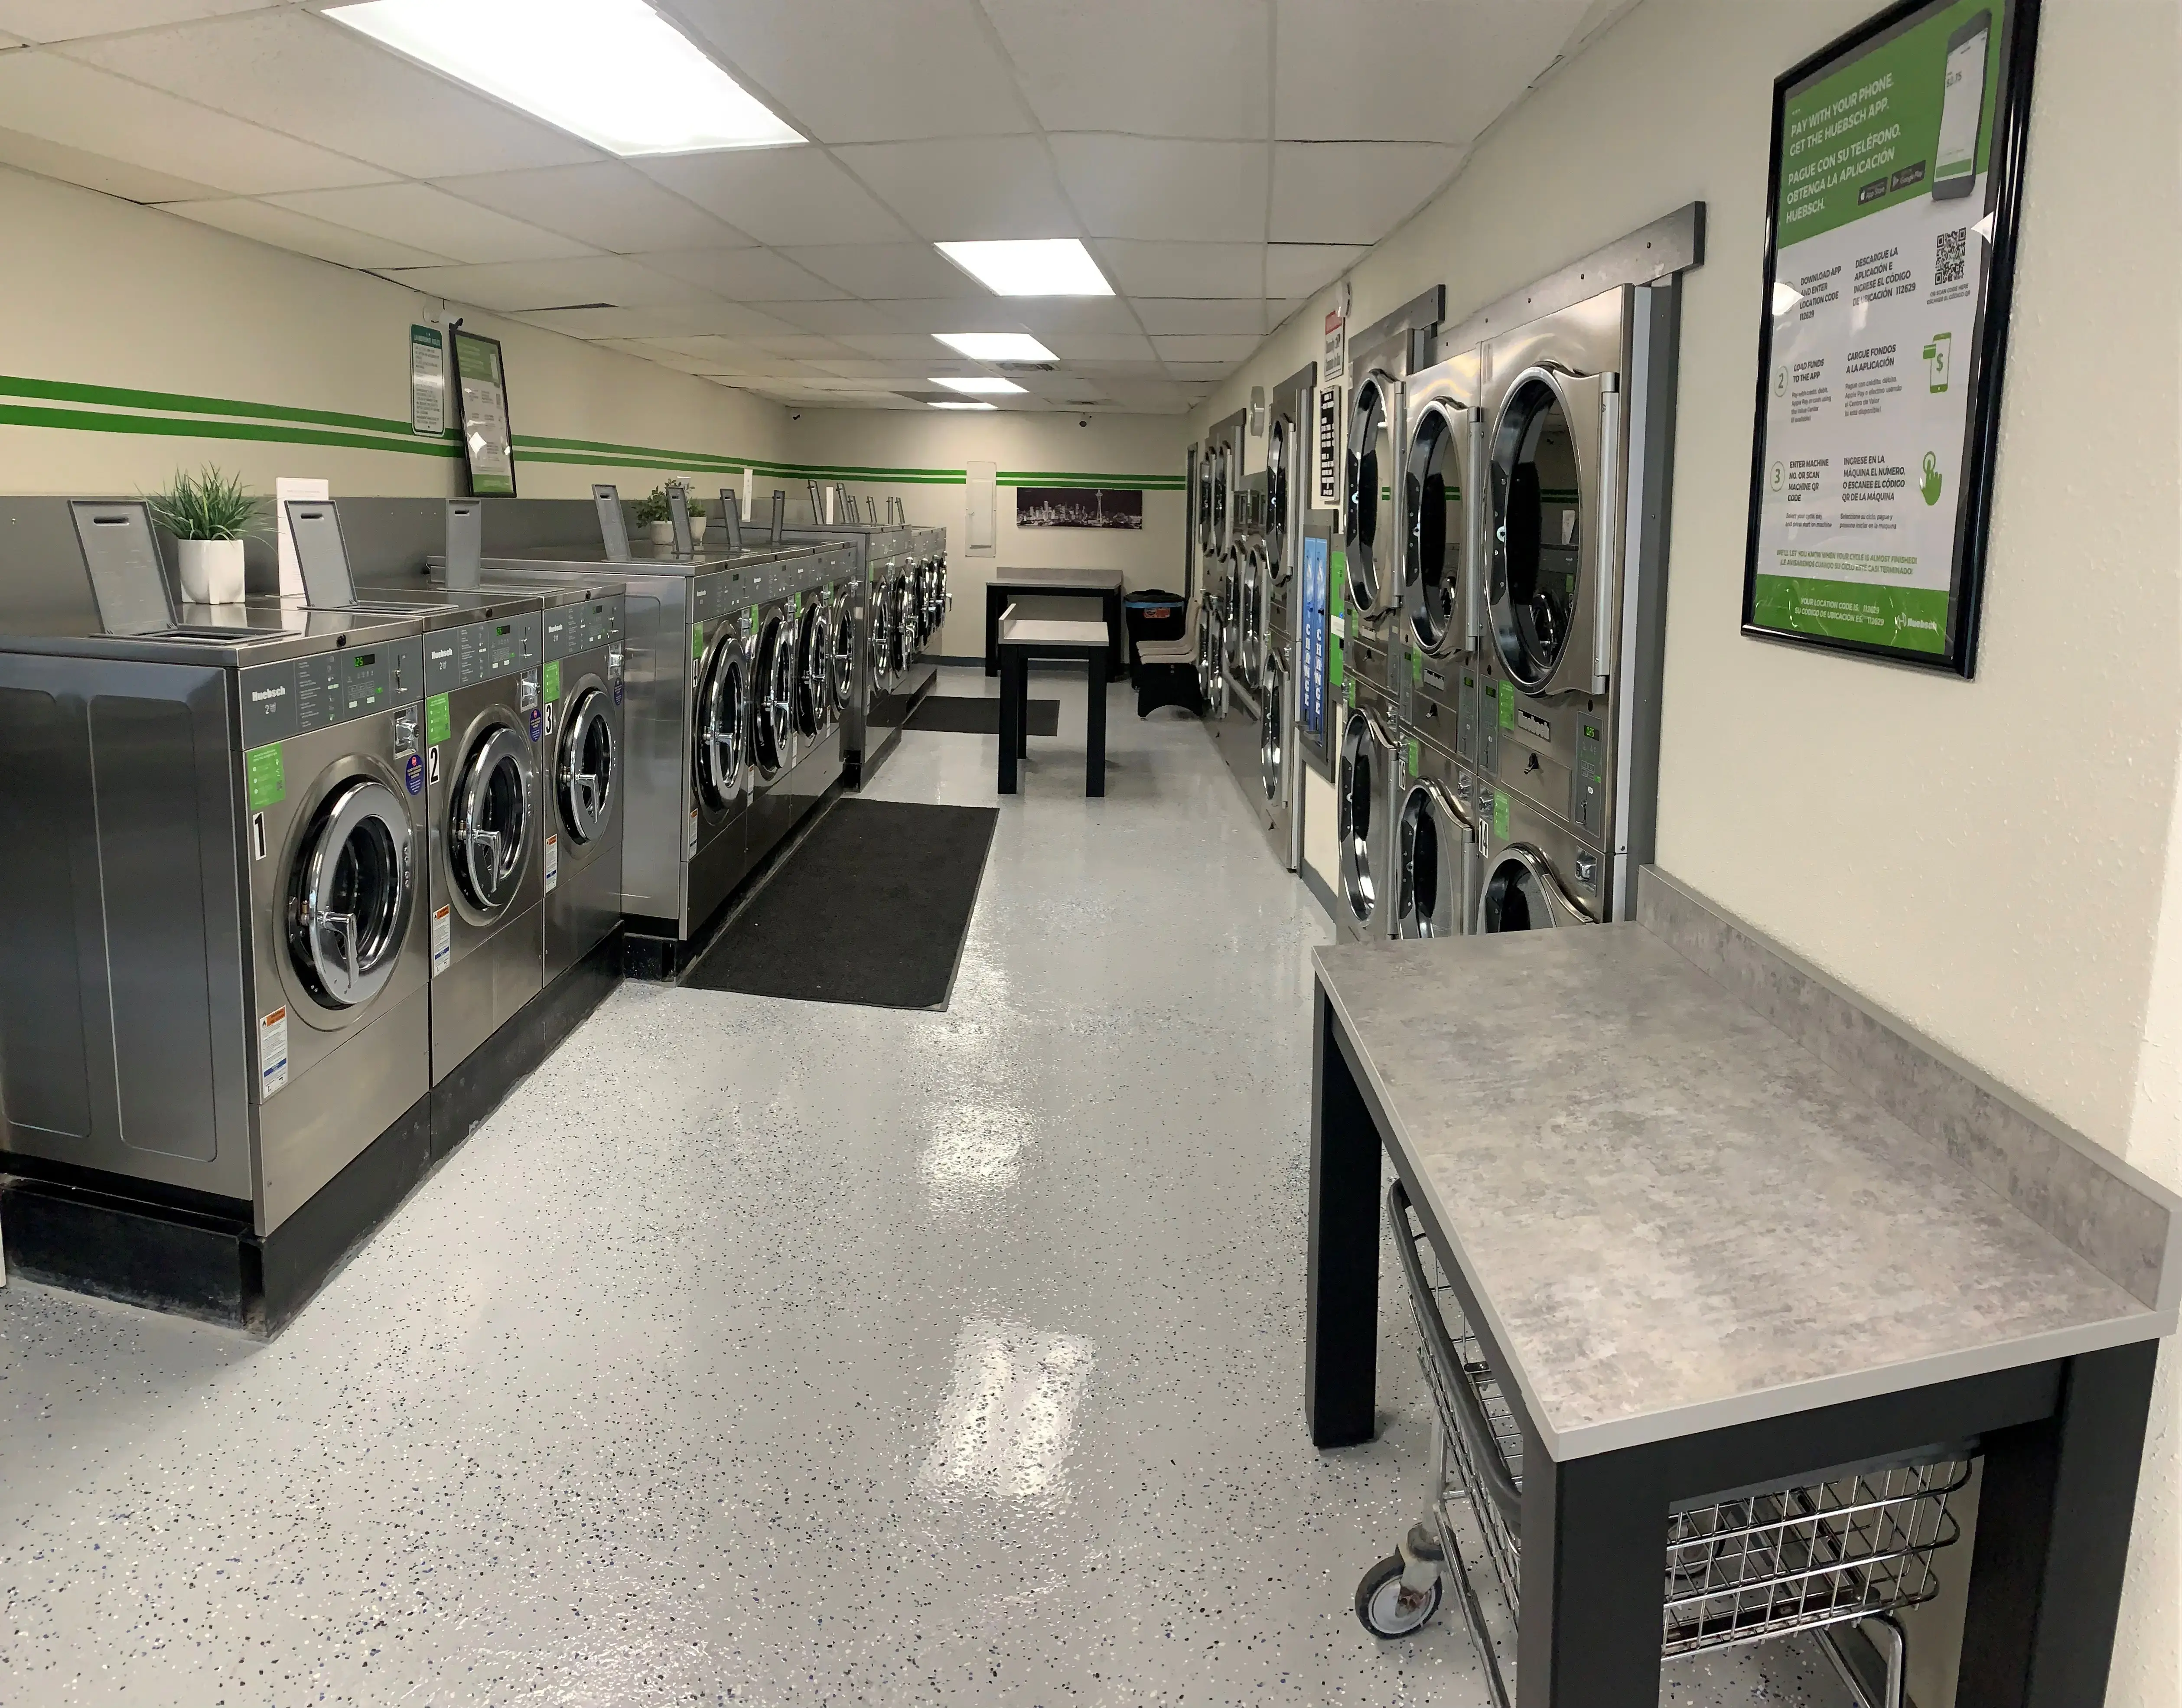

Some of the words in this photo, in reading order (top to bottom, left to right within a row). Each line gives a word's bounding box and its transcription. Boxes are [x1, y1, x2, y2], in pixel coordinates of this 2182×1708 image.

[1791, 118, 1807, 137] PAY
[1809, 105, 1831, 128] WITH
[1832, 92, 1857, 116] YOUR
[1790, 139, 1805, 156] GET
[1807, 130, 1823, 148] THE
[1824, 108, 1866, 140] HUEBSCH
[1868, 97, 1889, 118] APP.
[1788, 162, 1816, 186] PAGUE
[1817, 153, 1835, 172] CON
[1837, 147, 1849, 163] SU
[1850, 124, 1901, 157] TELÉFONO.
[1787, 178, 1825, 204] OBTENGA
[1827, 172, 1837, 188] LA
[1840, 146, 1895, 183] APLICACIÓN
[1786, 197, 1825, 223] HUEBSCH.
[1855, 249, 1889, 268] DESCARGUE
[1890, 247, 1898, 257] LA
[1801, 269, 1830, 286] DOWNLOAD
[1830, 266, 1841, 276] APP
[1854, 263, 1888, 281] APLICACIÓN
[1889, 261, 1893, 271] E
[1812, 282, 1827, 294] ENTER
[1853, 279, 1876, 294] INGRESE
[1877, 277, 1884, 287] EL
[1885, 270, 1911, 284] CÓDIGO
[1799, 296, 1824, 310] LOCATION
[1824, 291, 1839, 302] CODE
[1853, 296, 1860, 306] DE
[1896, 282, 1916, 295] 112629
[1800, 310, 1814, 321] 112629
[1847, 349, 1869, 361] CARGUE
[1870, 344, 1896, 356] FONDOS
[1794, 362, 1807, 372] LOAD
[1807, 359, 1824, 368] FUNDS
[1851, 364, 1858, 372] LA
[1859, 356, 1895, 371] APLICACIÓN
[1778, 373, 1784, 389] 2
[1800, 373, 1809, 381] THE
[1810, 371, 1820, 380] APP
[1806, 458, 1829, 467] MACHINE
[1844, 456, 1867, 465] INGRESE
[1868, 456, 1876, 464] EN
[1774, 468, 1780, 483] 3
[1843, 468, 1870, 478] MÁQUINA
[1811, 482, 1819, 490] QR
[1882, 478, 1905, 488] CÓDIGO
[1842, 493, 1850, 502] QR
[1867, 490, 1895, 502] MÁQUINA
[1815, 561, 1834, 569] CUANDO
[1801, 597, 1814, 606] YOUR
[1814, 599, 1839, 609] LOCATION
[1839, 602, 1853, 611] CODE
[1863, 605, 1879, 614] 112629
[1867, 616, 1884, 626] 112629
[252, 685, 286, 701] Huebsch
[265, 704, 269, 714] 2
[546, 705, 551, 733] 3
[430, 747, 438, 782] 2
[255, 814, 265, 857] 1
[1480, 820, 1488, 857] 14
